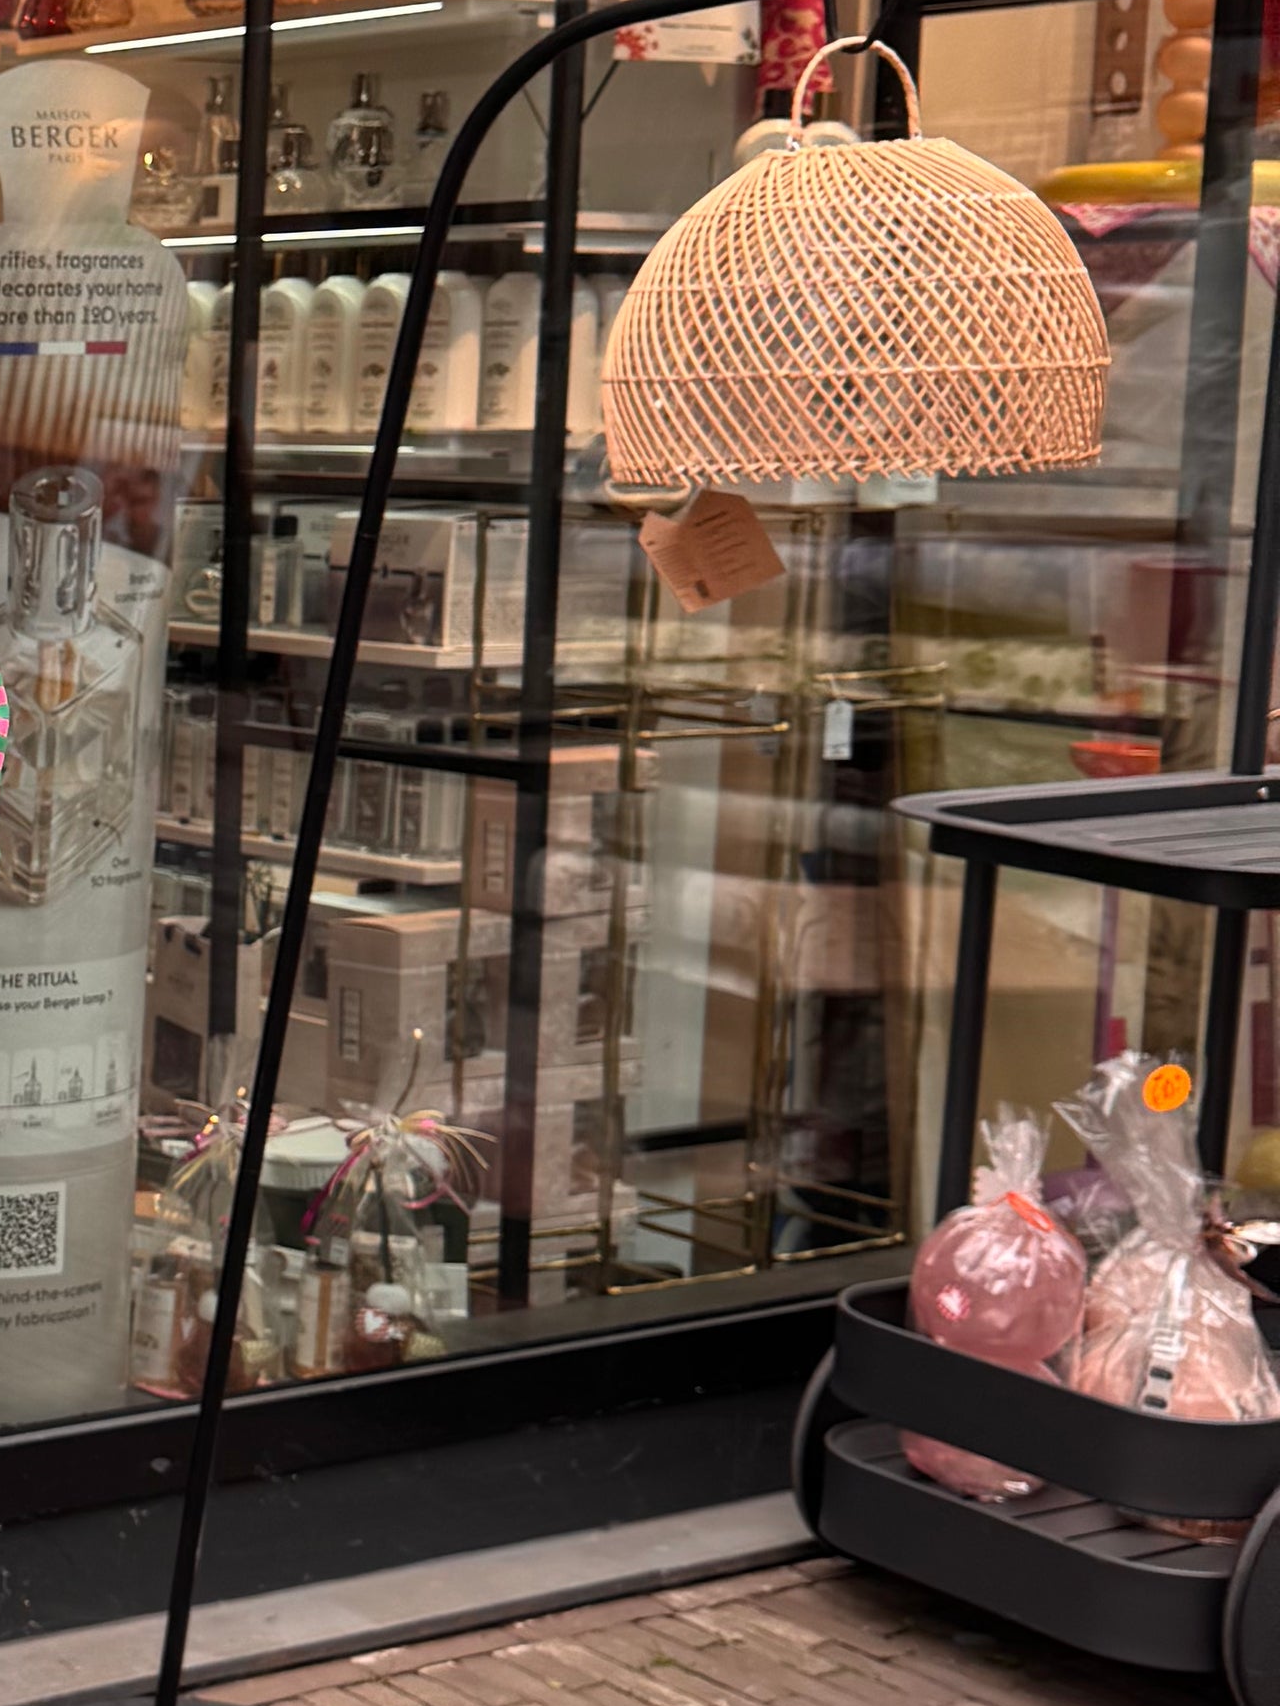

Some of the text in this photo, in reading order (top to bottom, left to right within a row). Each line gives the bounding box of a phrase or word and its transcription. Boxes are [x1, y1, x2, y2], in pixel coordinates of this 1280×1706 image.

[35, 109, 91, 121] MAISON
[11, 125, 118, 149] BERGER
[48, 152, 85, 164] PARIS
[56, 251, 144, 273] fragrances
[86, 283, 122, 300] your
[125, 280, 163, 297] home
[34, 306, 76, 324] than
[27, 970, 78, 988] RITUAL
[14, 1000, 41, 1012] your
[43, 996, 80, 1010] Berger
